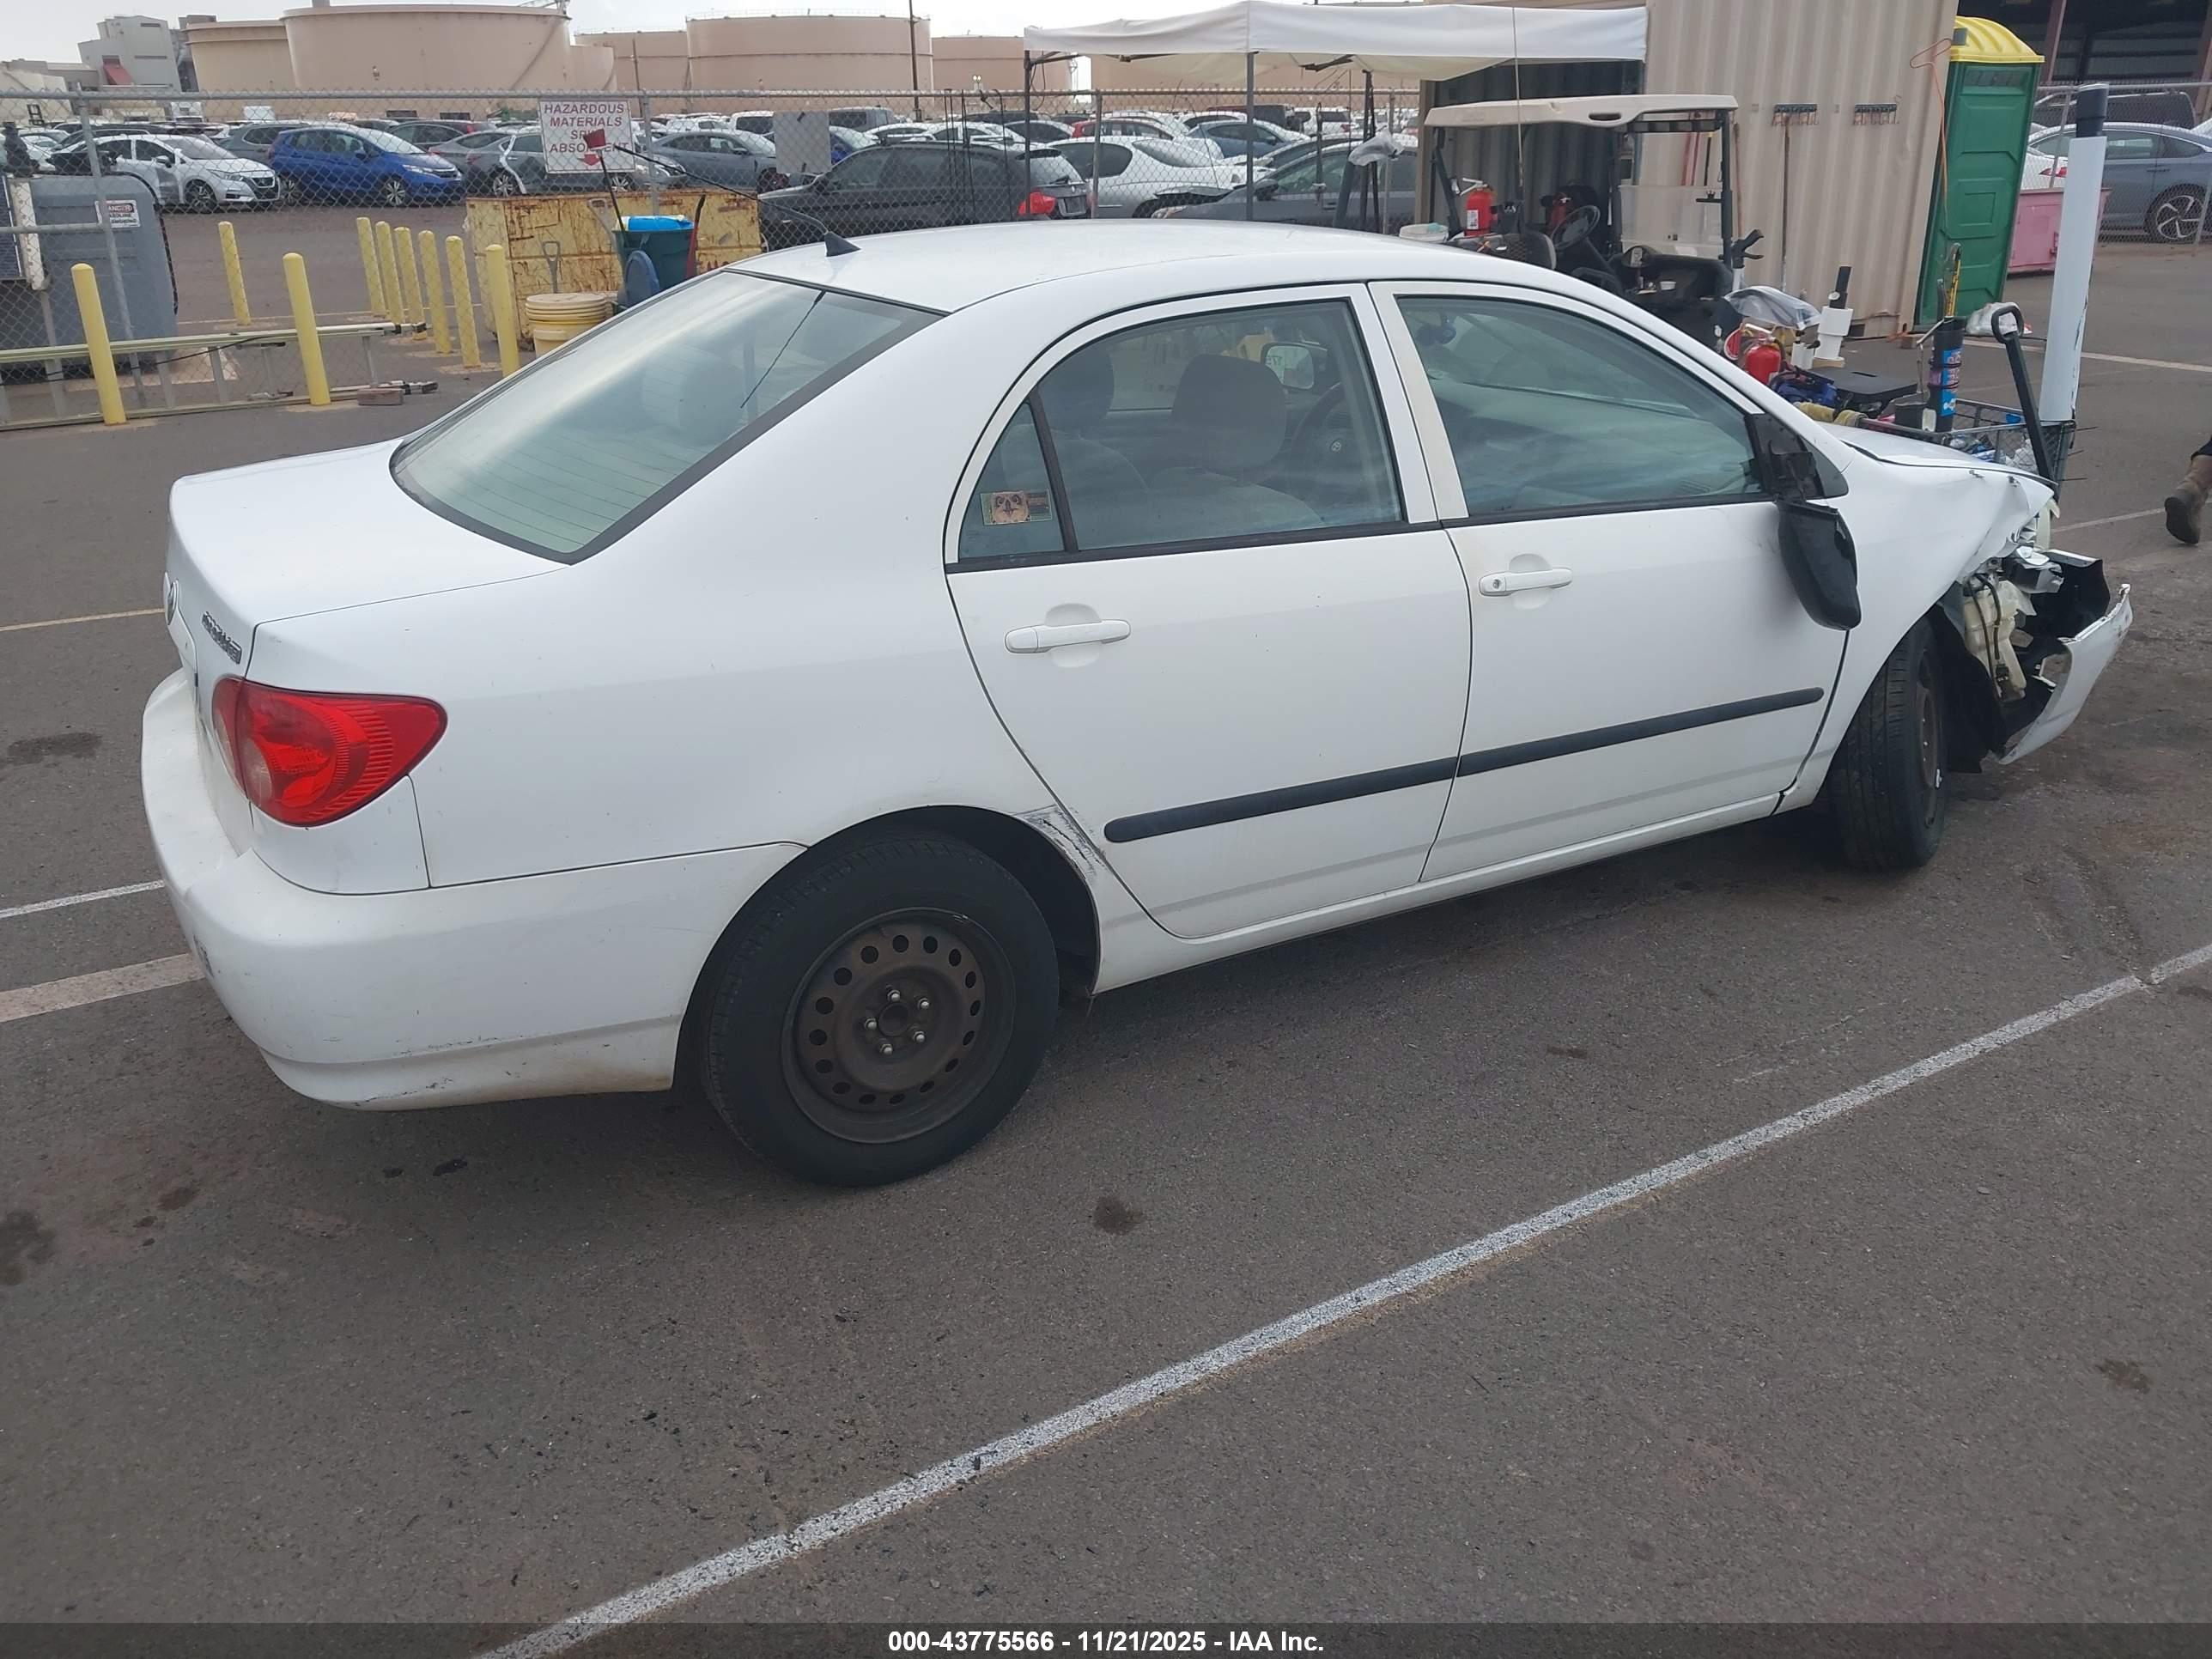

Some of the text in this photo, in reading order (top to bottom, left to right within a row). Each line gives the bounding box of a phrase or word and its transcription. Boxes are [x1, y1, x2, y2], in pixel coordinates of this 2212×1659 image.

[544, 103, 624, 114] HAZARDOUS
[550, 116, 623, 127] MATERIALS
[550, 143, 629, 153] ABSOENT
